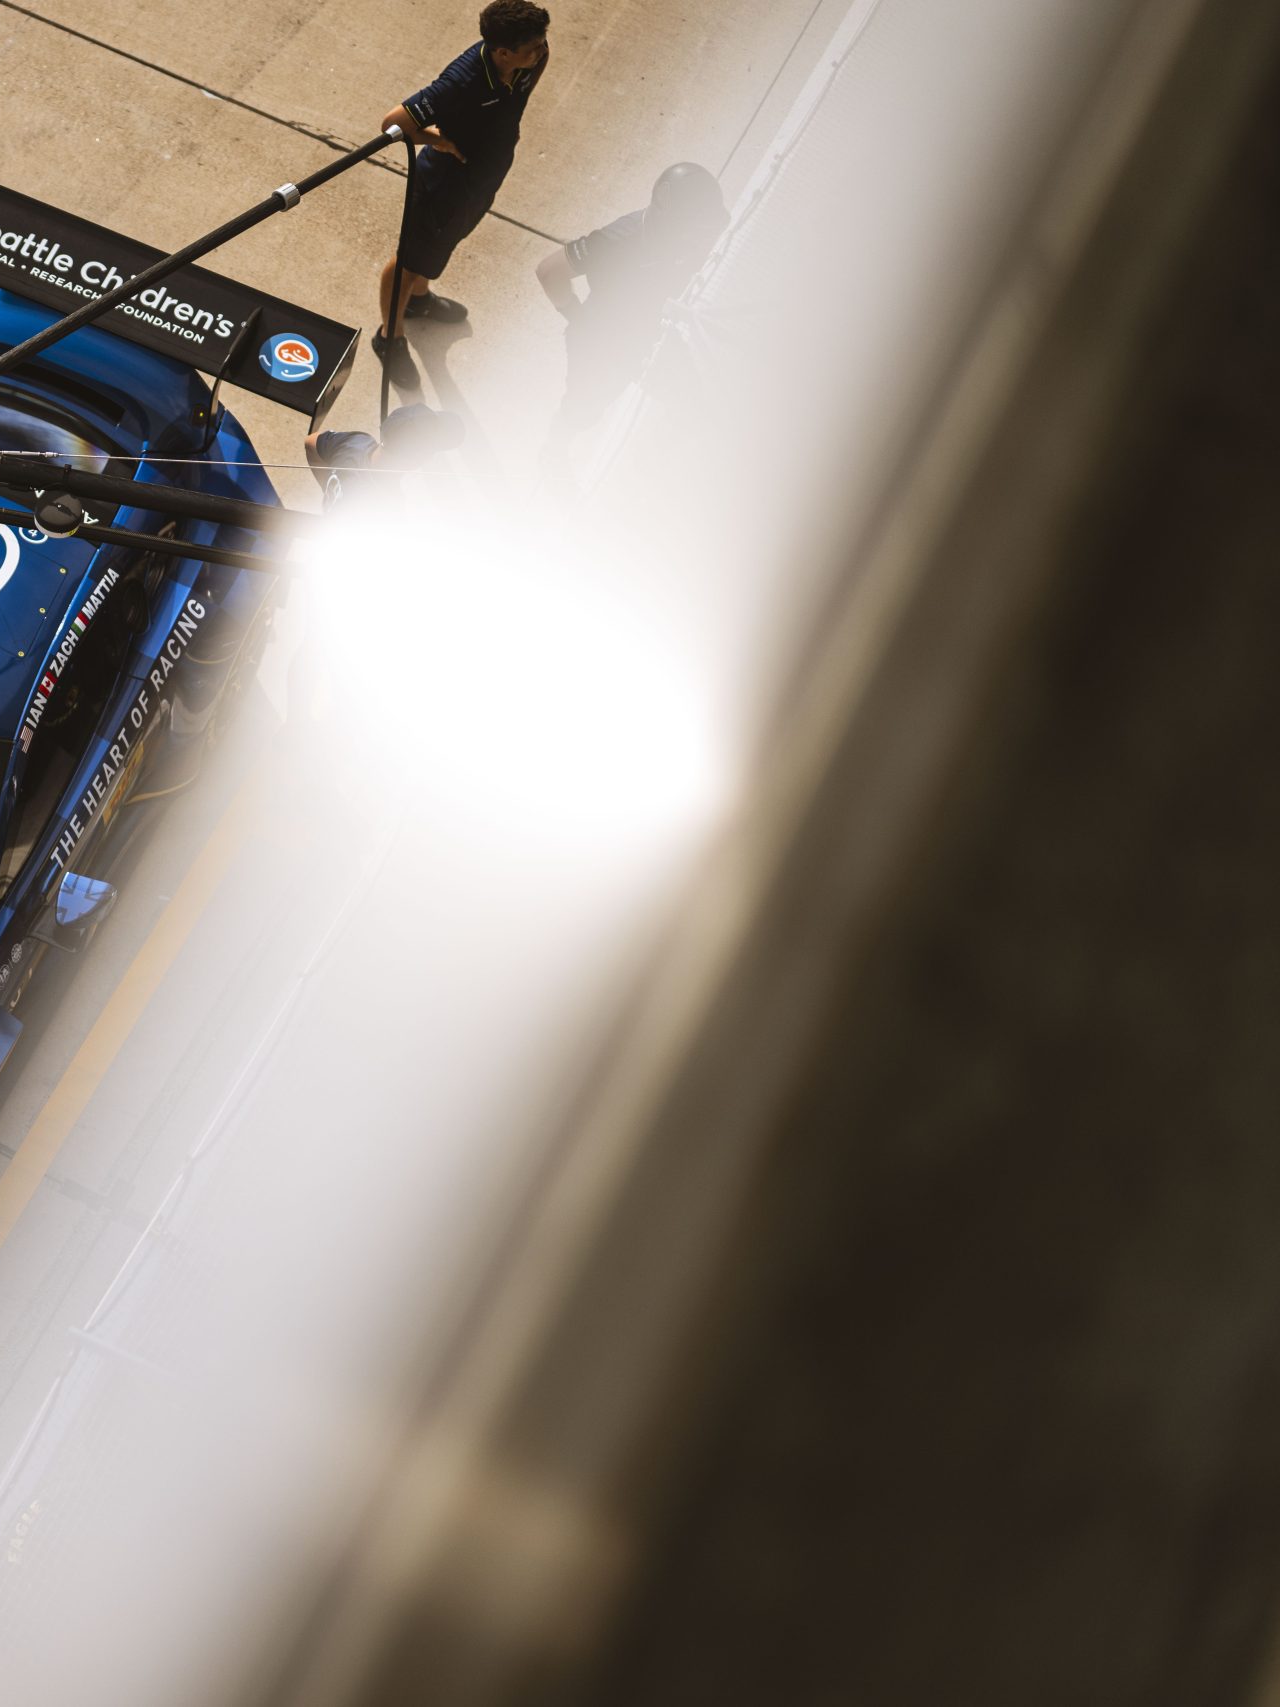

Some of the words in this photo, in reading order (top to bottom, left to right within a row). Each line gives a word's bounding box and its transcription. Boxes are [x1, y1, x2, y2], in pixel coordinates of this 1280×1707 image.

[30, 267, 104, 300] RESEARCH
[115, 302, 205, 344] FOUNDATION
[80, 261, 234, 338] Chdren's
[25, 693, 48, 728] IAN
[50, 629, 79, 678] ZACH
[80, 567, 120, 620] MATTIA
[50, 816, 85, 869] THE
[82, 728, 131, 816] HEART
[130, 692, 151, 730] OF
[148, 600, 206, 693] RACING
